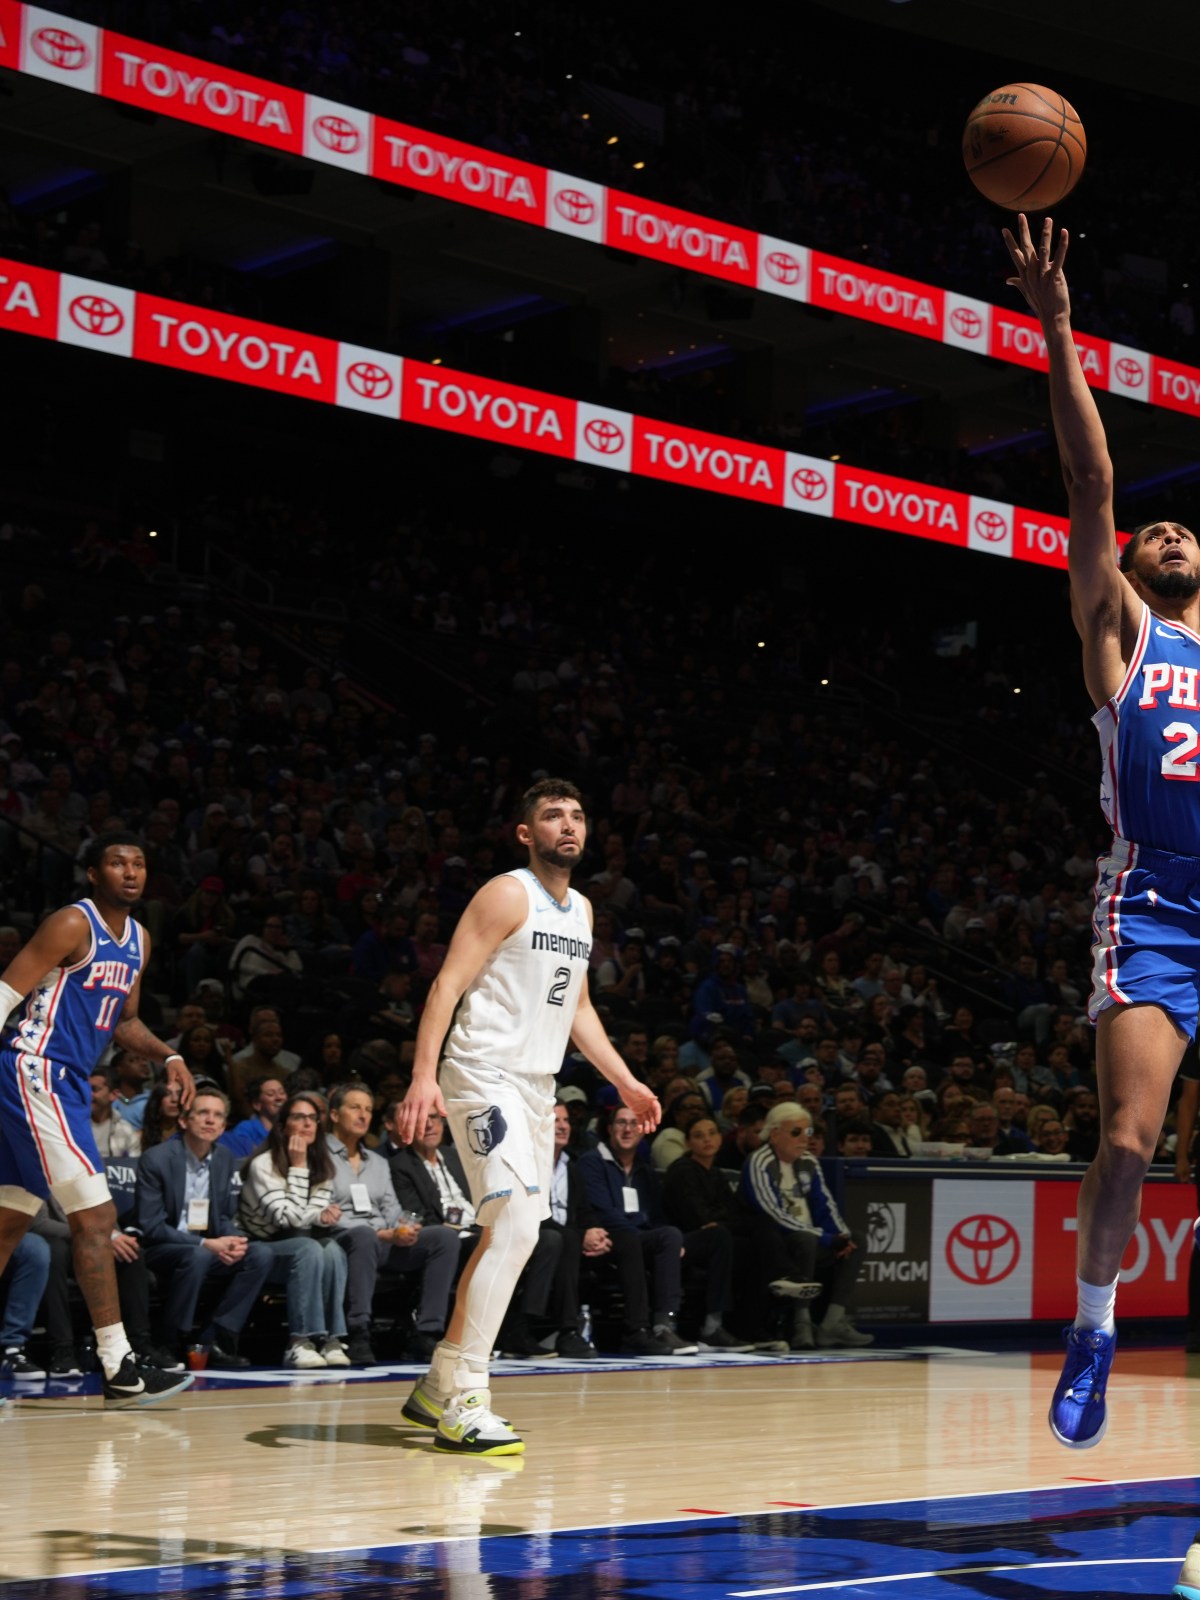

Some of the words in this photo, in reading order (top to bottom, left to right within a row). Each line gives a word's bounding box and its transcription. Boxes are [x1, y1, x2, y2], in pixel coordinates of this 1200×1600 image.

[117, 53, 289, 132] TOYOTA
[385, 137, 534, 206] TOYOTA
[617, 207, 747, 269] TOYOTA
[819, 268, 934, 324] TOYOTA
[153, 315, 321, 383] TOYOTA
[417, 379, 562, 441] TOYOTA
[645, 434, 772, 488] TOYOTA
[845, 480, 958, 530] TOYOTA
[95, 995, 119, 1031] 11
[546, 966, 571, 1007] 2
